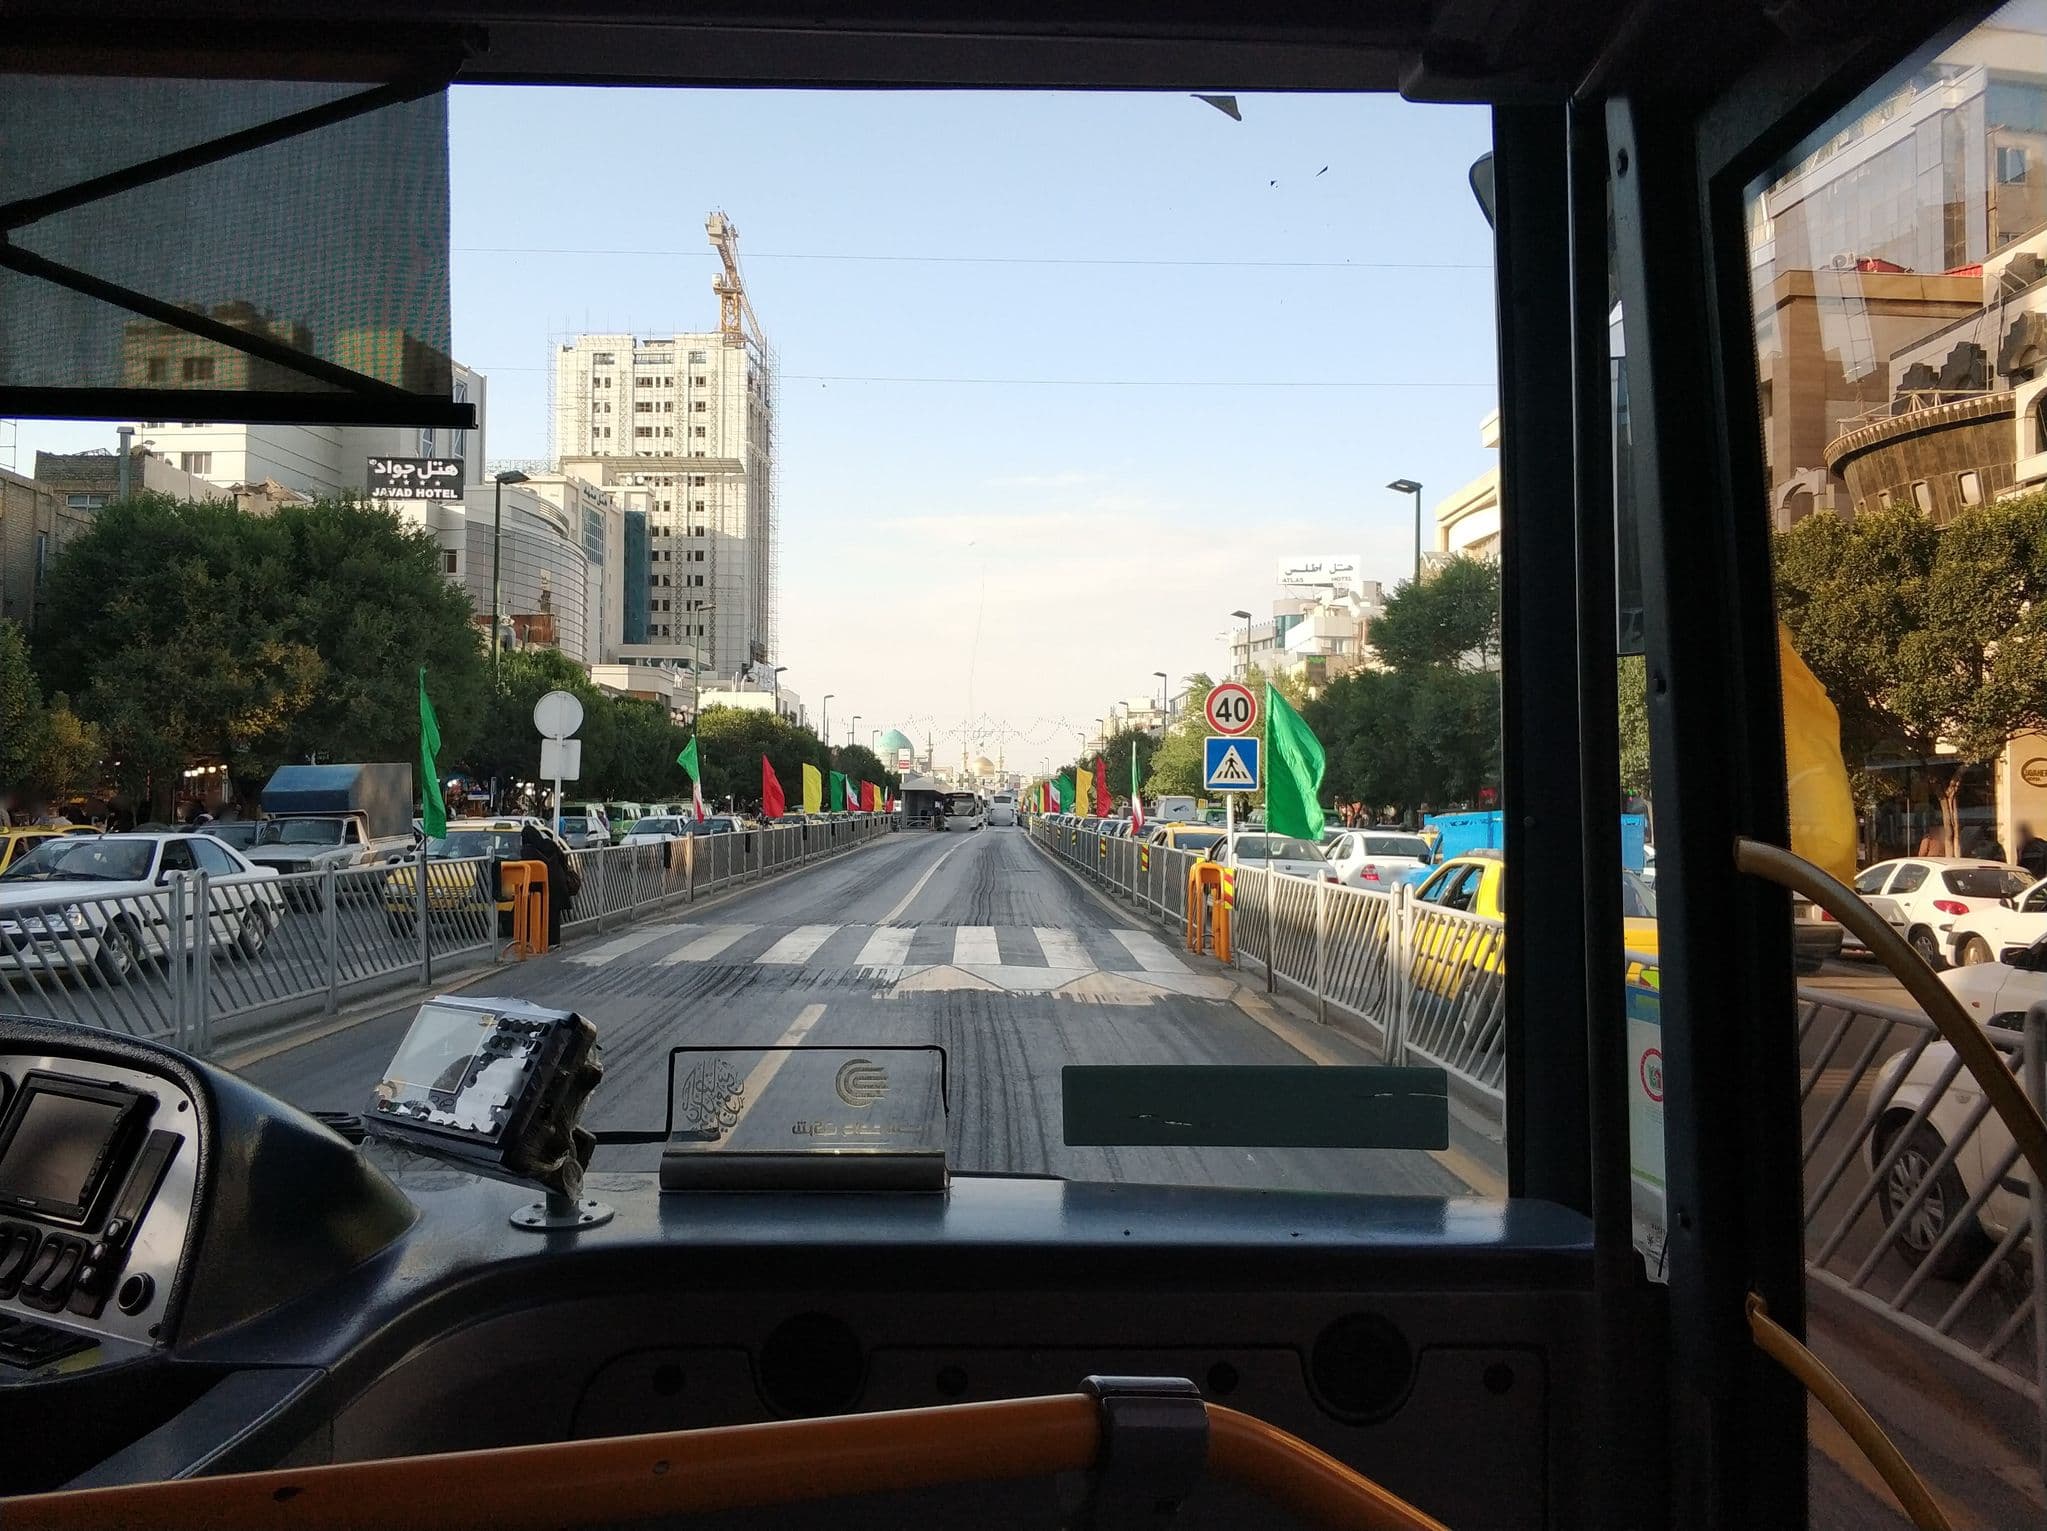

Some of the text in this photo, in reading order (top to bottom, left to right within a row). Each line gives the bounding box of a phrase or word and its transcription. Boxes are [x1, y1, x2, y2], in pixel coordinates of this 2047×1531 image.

[374, 460, 459, 479] هتل جواد
[372, 487, 458, 499] JAVAD HOTEL
[1284, 562, 1354, 576] هتل اطلس
[1215, 696, 1249, 723] 40
